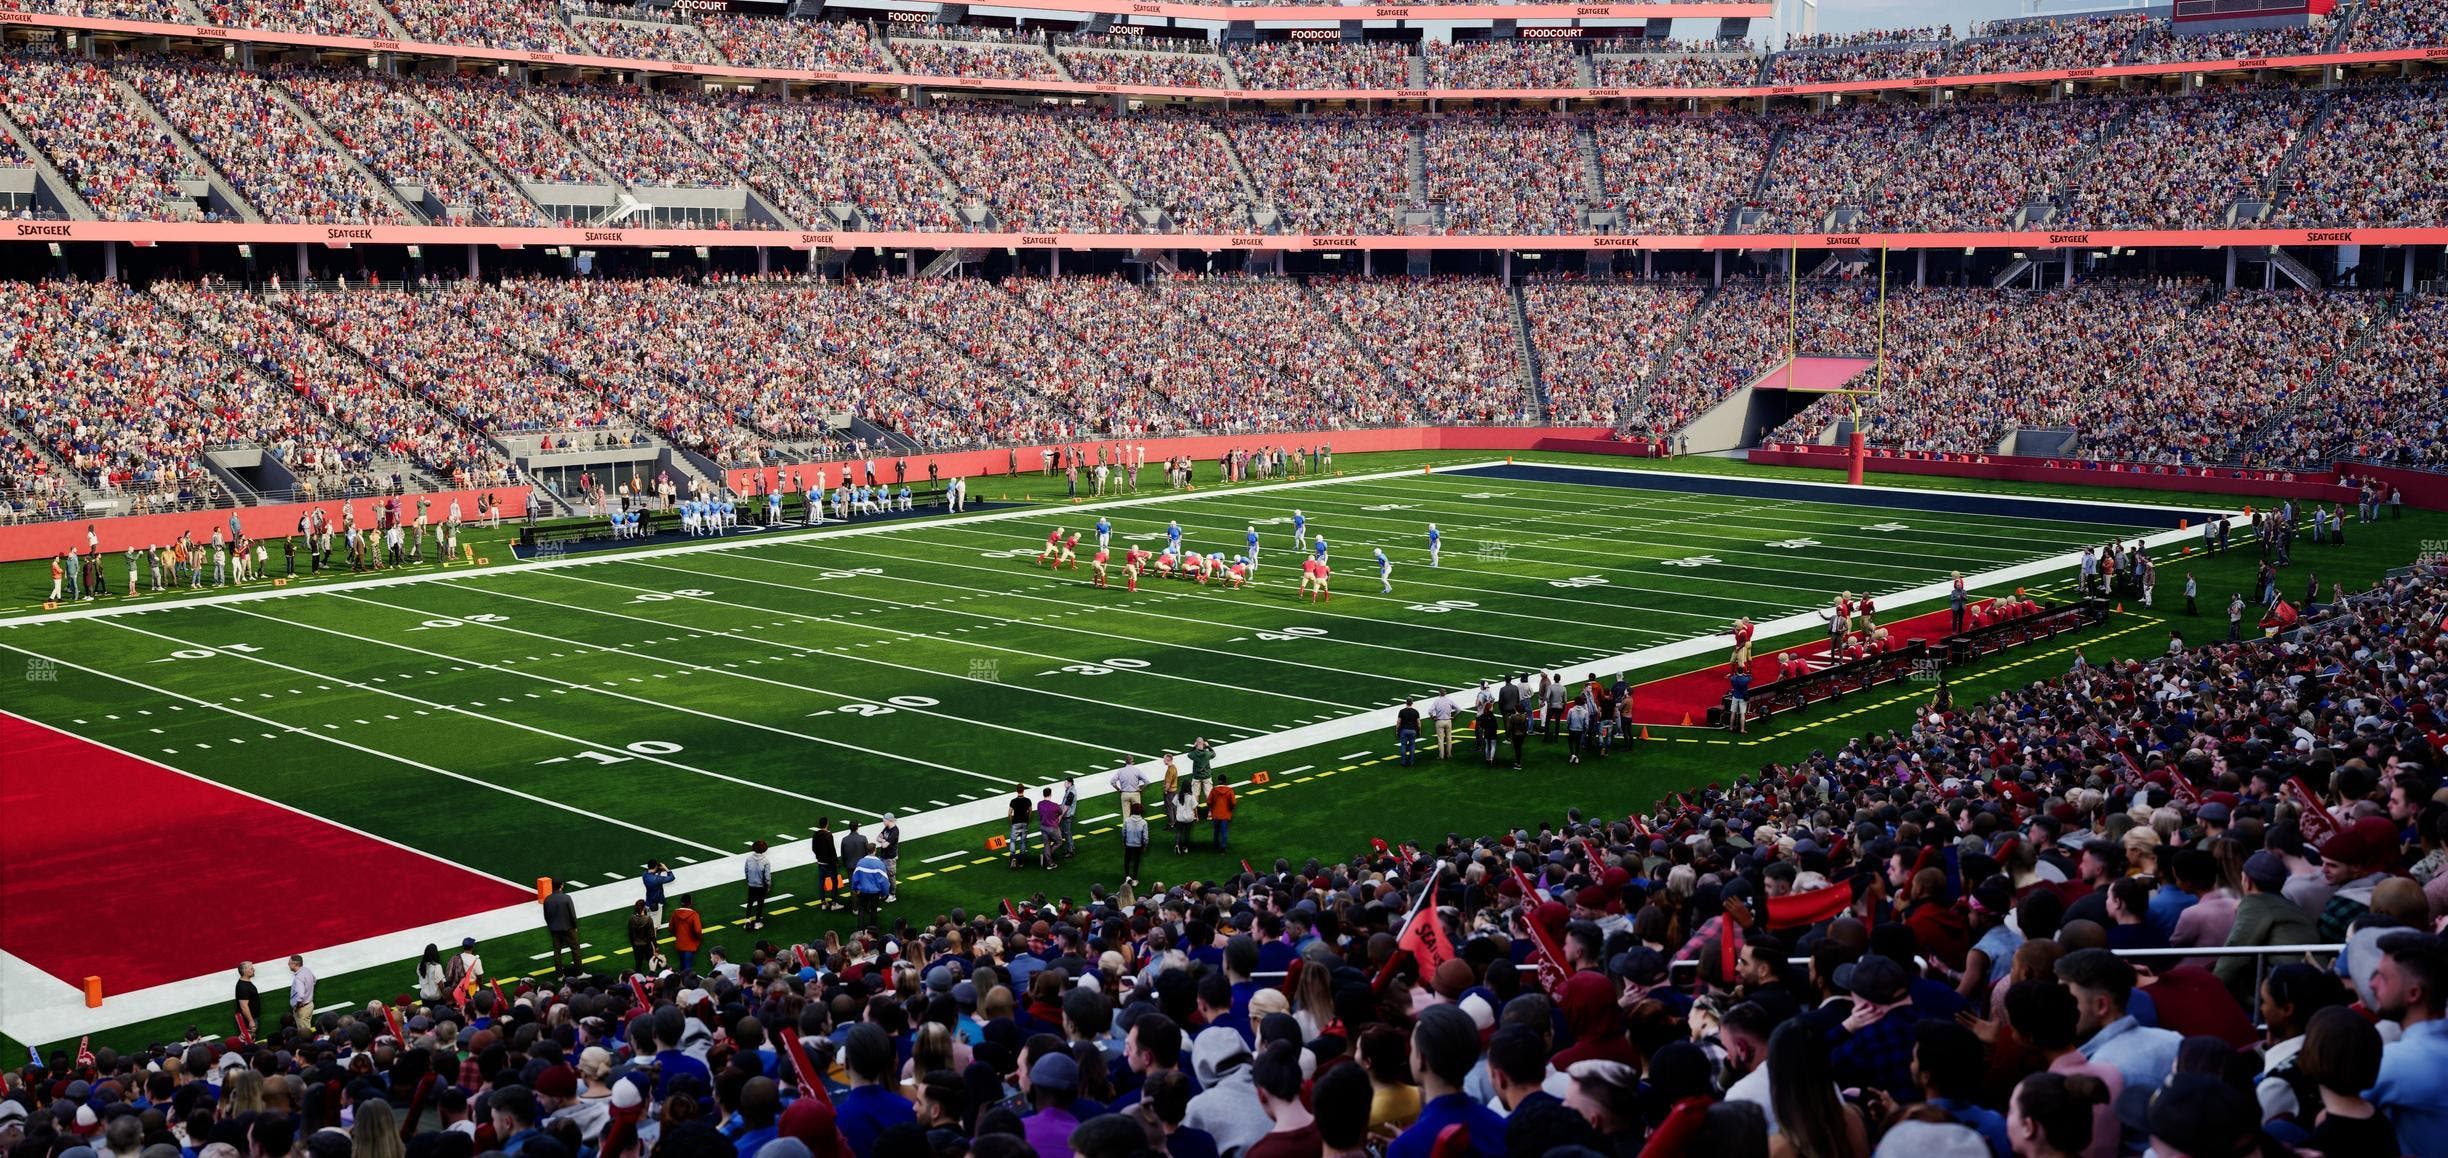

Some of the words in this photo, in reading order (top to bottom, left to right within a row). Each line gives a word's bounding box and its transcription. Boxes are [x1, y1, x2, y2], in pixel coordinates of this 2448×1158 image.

[197, 28, 226, 37] SEATGEEK
[1523, 29, 1583, 37] FOODCOURT
[2238, 60, 2267, 68] SEATGEEK
[18, 225, 71, 236] SEATGEEK
[328, 229, 372, 239] SEATGEEK
[585, 232, 622, 241] SEATGEEK
[802, 235, 834, 243] SEATGEEK
[1023, 237, 1057, 245] SEATGEEK
[2049, 235, 2088, 244] SEATGEEK
[2307, 232, 2352, 242] SEATGEEK
[1231, 238, 1263, 246] SEATGEEK
[1313, 239, 1357, 247] SEATGEEK
[1594, 239, 1639, 247] SEATGEEK
[1826, 237, 1861, 246] SEATGEEK
[1404, 600, 1479, 613] 50
[1255, 626, 1328, 641] 40
[1061, 658, 1151, 676] 30
[837, 695, 940, 717] 20
[573, 740, 684, 765] 10
